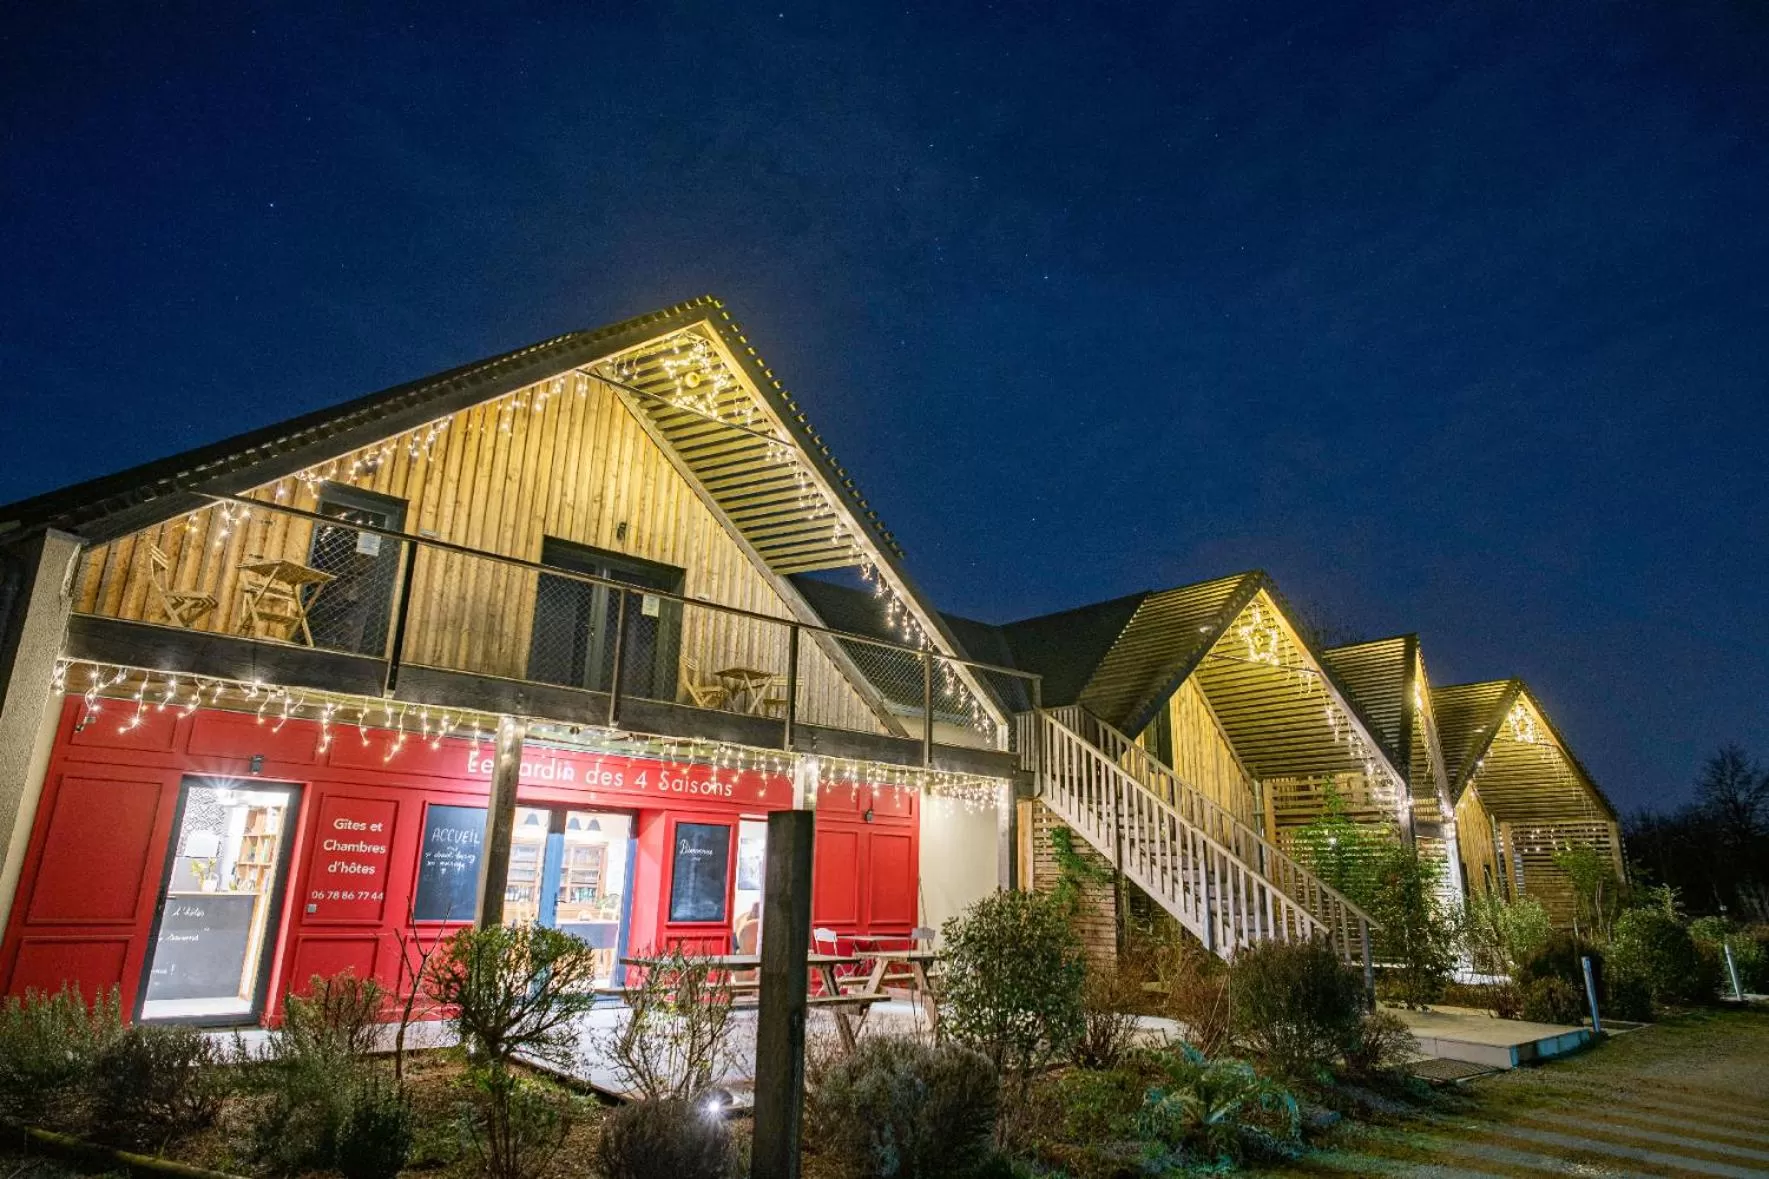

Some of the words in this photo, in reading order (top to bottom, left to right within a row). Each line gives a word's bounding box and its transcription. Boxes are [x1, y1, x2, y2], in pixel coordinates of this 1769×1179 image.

[519, 757, 575, 782] ardin
[585, 762, 624, 787] des
[634, 770, 647, 788] 4
[658, 771, 733, 797] Saisons
[333, 818, 367, 831] Gîtes
[369, 823, 383, 832] et
[431, 827, 480, 844] ACCUEIL
[323, 839, 386, 854] Chambres
[327, 861, 376, 874] d'hôtes
[311, 890, 325, 899] 06
[327, 890, 339, 900] 78
[341, 891, 355, 900] 86
[356, 891, 369, 900] 77
[371, 891, 384, 900] 44
